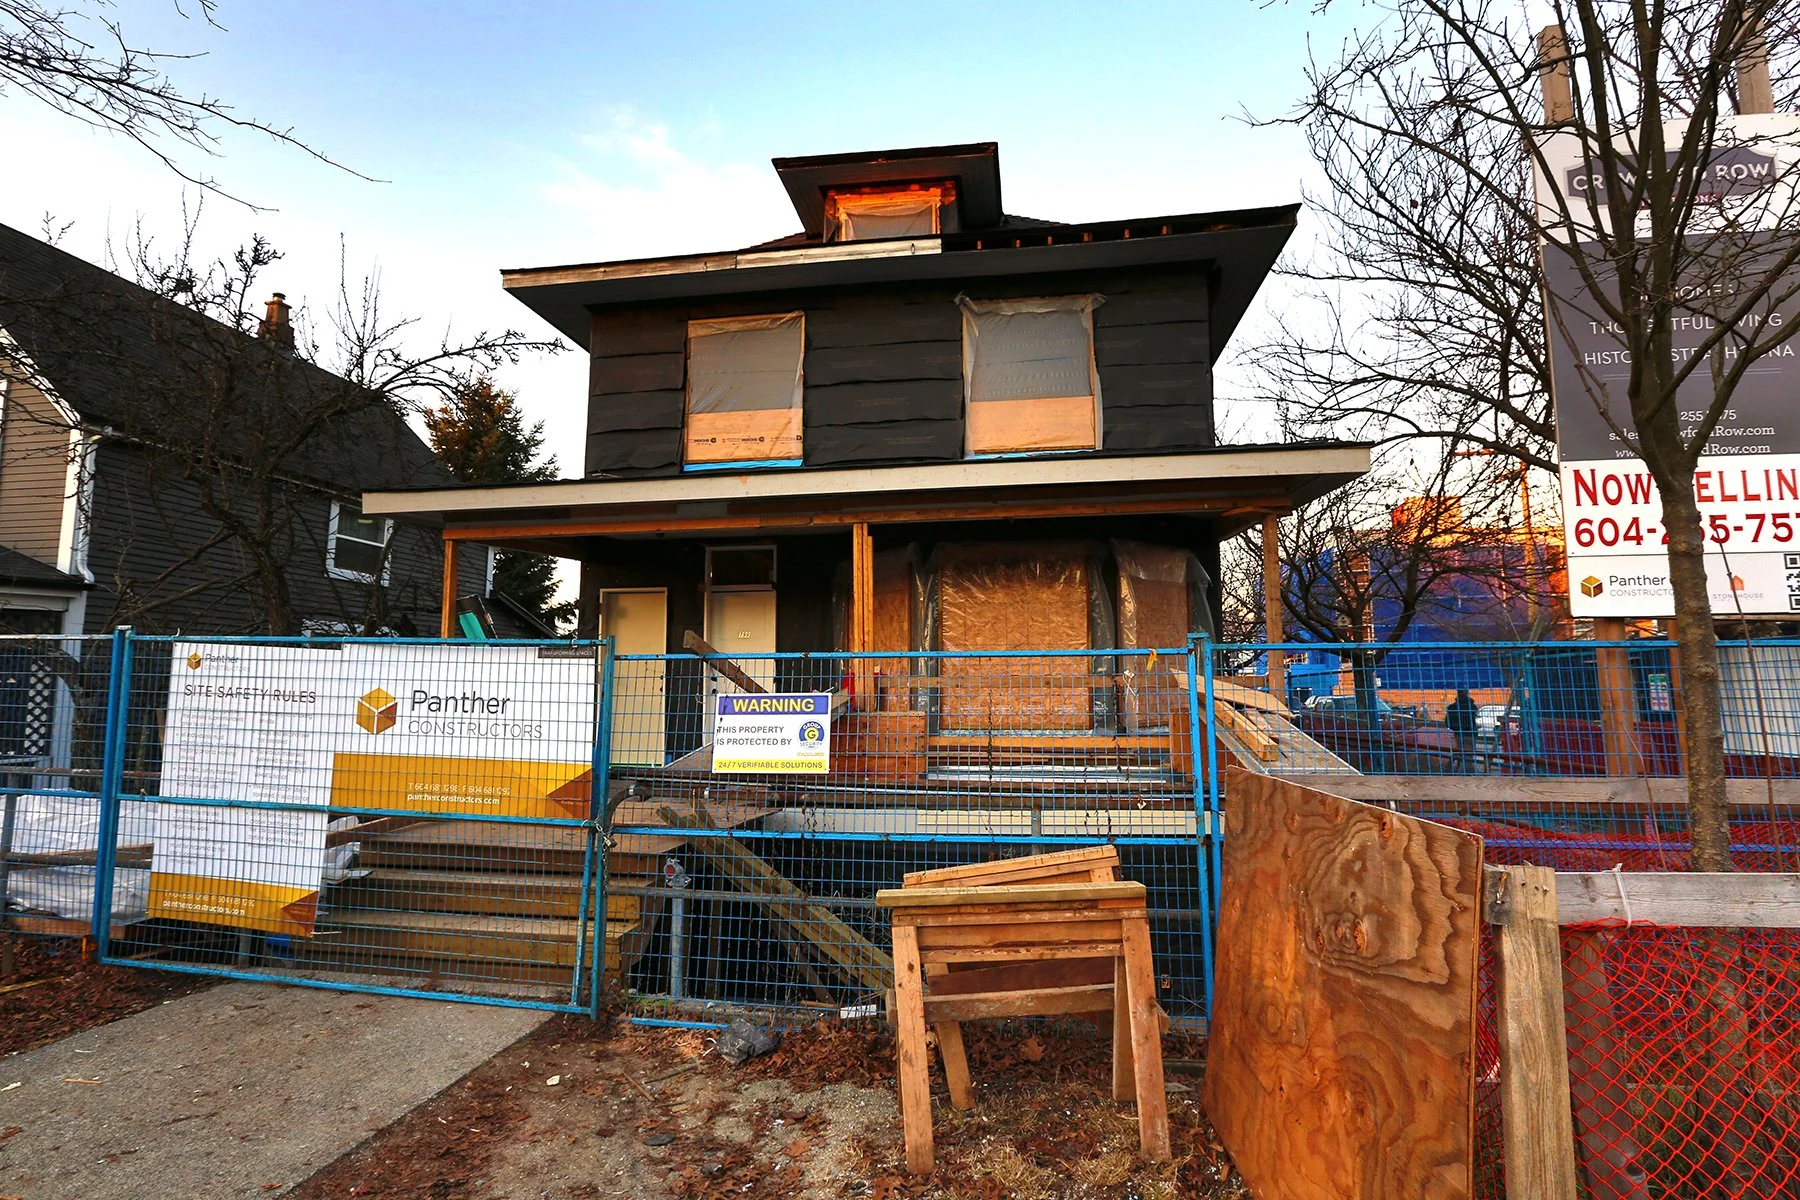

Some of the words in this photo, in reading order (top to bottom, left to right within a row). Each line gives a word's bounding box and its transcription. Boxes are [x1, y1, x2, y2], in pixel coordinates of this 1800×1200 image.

[1715, 162, 1770, 181] ROW
[1589, 316, 1715, 335] THOTFUL
[1573, 468, 1654, 507] NOW
[1693, 468, 1800, 503] ELLIN
[1574, 512, 1800, 548] 604-5-75
[1609, 574, 1666, 587] Panther
[1609, 588, 1675, 597] CONSTRUCTO
[1712, 592, 1765, 600] STONHOUSE
[184, 684, 213, 698] SITE
[217, 685, 269, 701] SAFETY
[273, 689, 317, 704] RULES
[411, 689, 511, 715] Panther
[733, 698, 815, 713] WARNING
[408, 719, 543, 739] CONSTRUCTORS
[718, 726, 737, 734] THIS
[738, 726, 784, 734] PROPERTY
[806, 729, 817, 740] G
[716, 738, 725, 746] IS
[726, 738, 778, 746] PROTECTED
[780, 738, 793, 746] BY
[718, 761, 737, 769] 24/7
[738, 761, 779, 769] VERIFIABLE
[780, 761, 823, 769] SOLUTIONS
